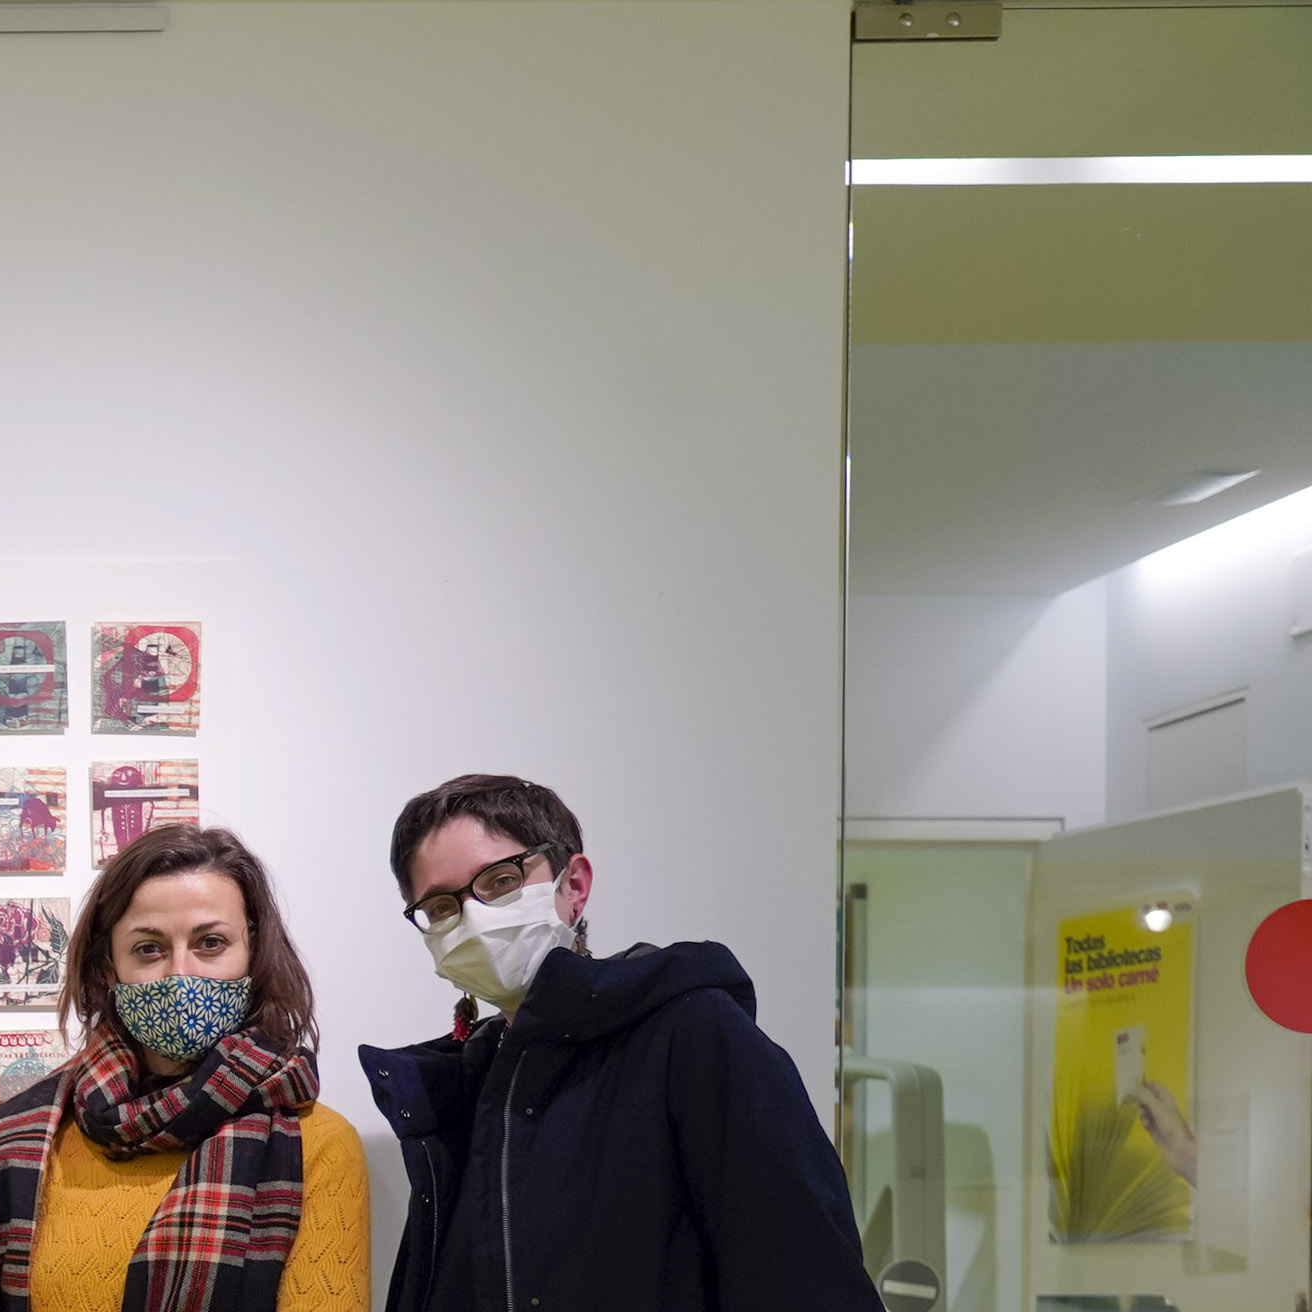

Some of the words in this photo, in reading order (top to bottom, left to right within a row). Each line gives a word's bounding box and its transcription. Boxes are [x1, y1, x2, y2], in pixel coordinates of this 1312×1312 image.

[1064, 933, 1106, 955] Todas
[1064, 956, 1084, 975] las
[1087, 947, 1162, 972] bibliotecas
[1064, 974, 1083, 995] Un
[1087, 970, 1115, 992] solo
[1118, 966, 1160, 988] carné
